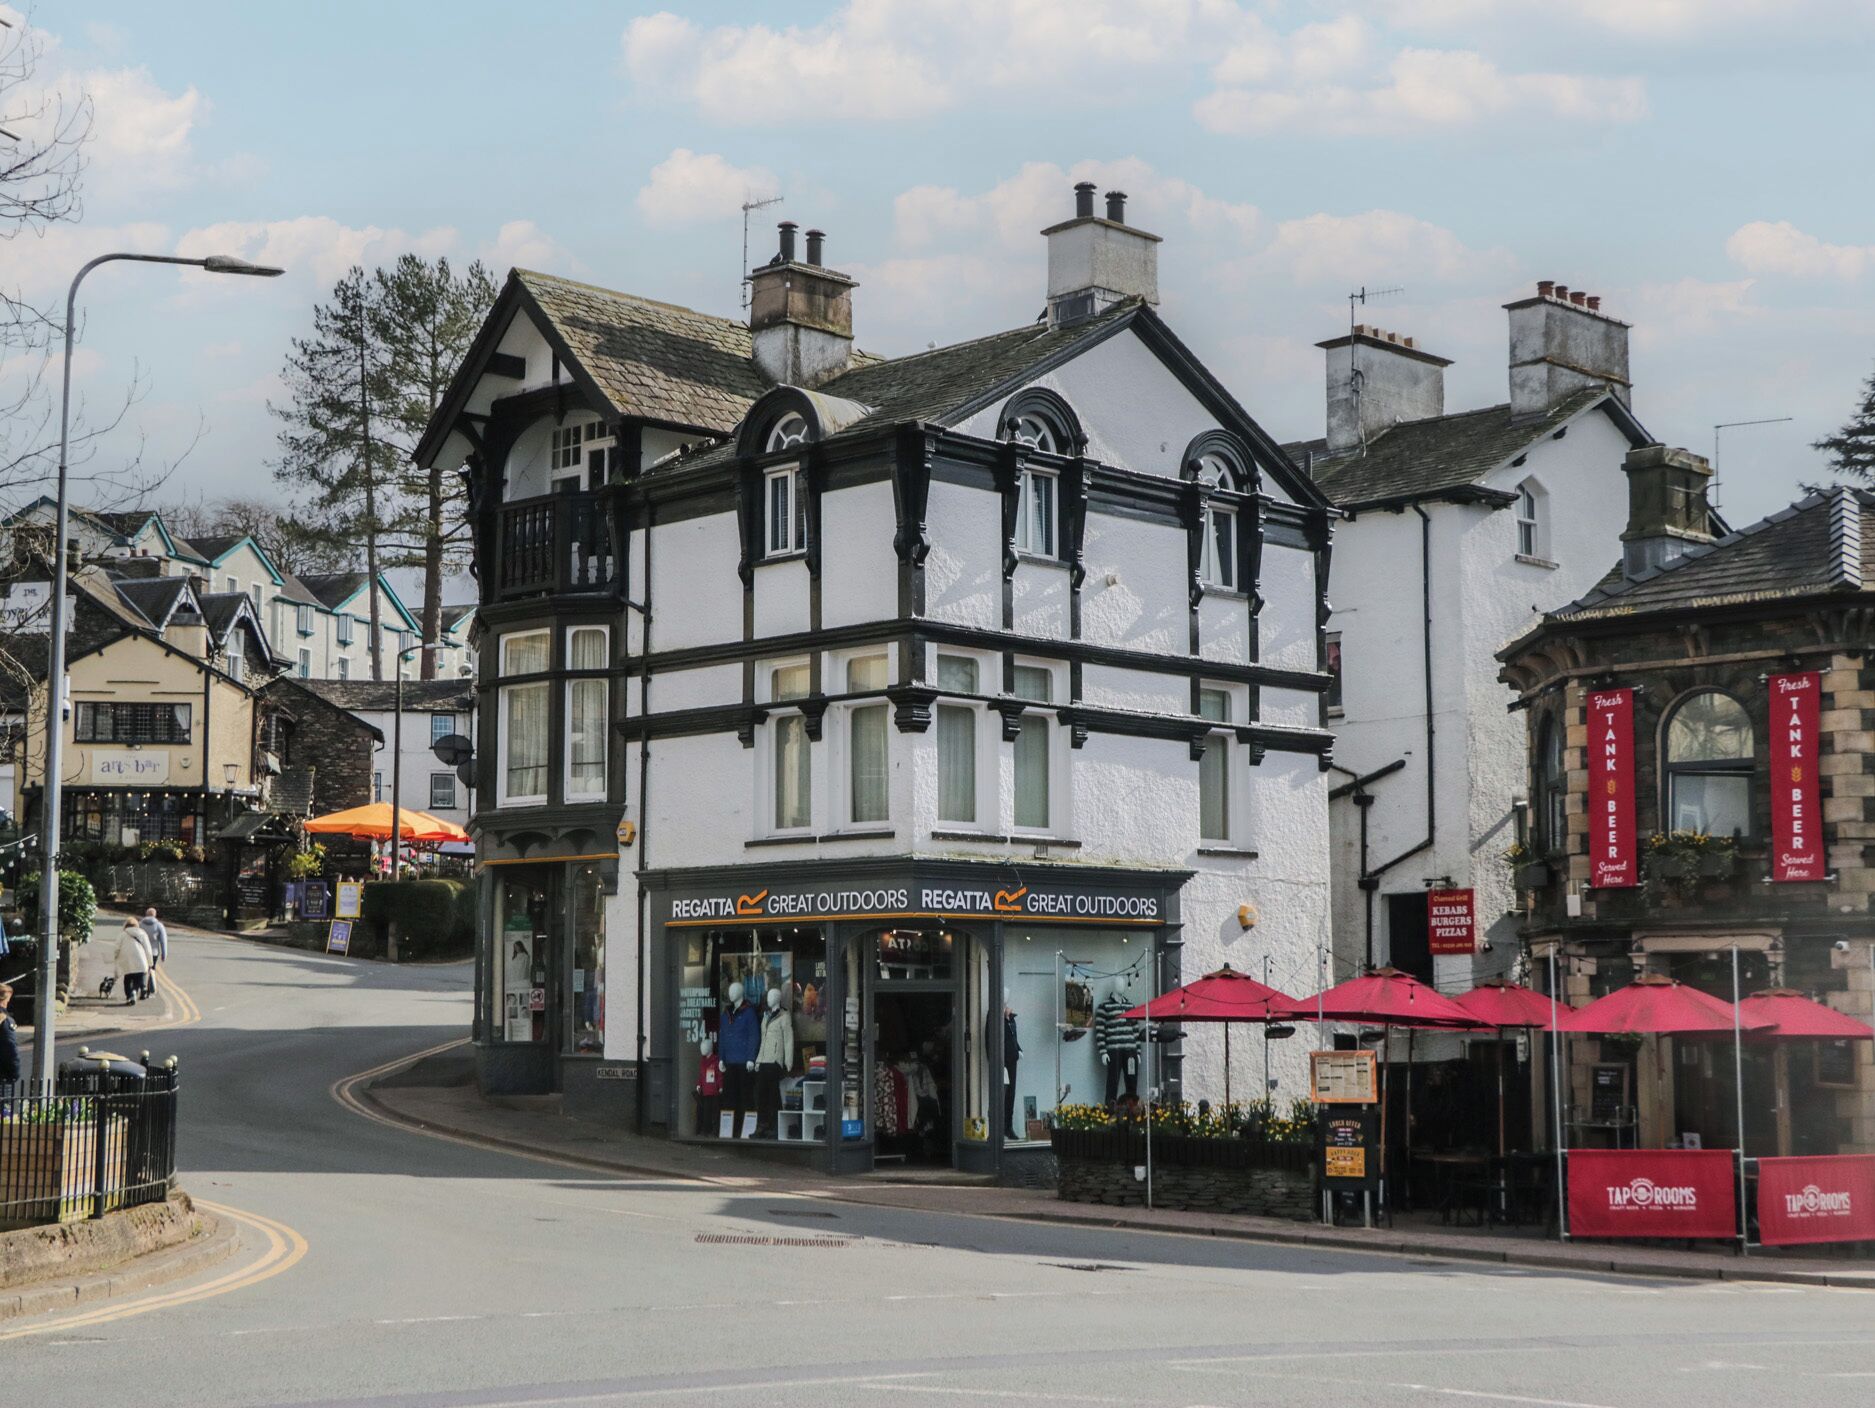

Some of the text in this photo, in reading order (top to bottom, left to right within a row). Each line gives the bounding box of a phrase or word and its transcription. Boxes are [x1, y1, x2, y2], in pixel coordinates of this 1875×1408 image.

[1777, 676, 1811, 694] Fresh
[1594, 693, 1623, 710] Fresh
[135, 760, 160, 774] bar
[1789, 696, 1804, 849] TANK BEER
[1605, 713, 1617, 858] TANK BEER
[1598, 861, 1628, 875] Served
[1781, 853, 1815, 867] Served
[1603, 873, 1625, 885] Here
[1785, 866, 1810, 881] Here
[672, 897, 735, 918] REGATTA
[768, 893, 815, 913] GREAT
[817, 889, 908, 912] OUTDOORS
[922, 889, 992, 911] REGATTA
[1027, 893, 1073, 913] GREAT
[1076, 895, 1157, 915] OUTDOORS
[1432, 905, 1468, 915] KEBABS
[1431, 916, 1472, 926] BURGERS
[1436, 927, 1467, 937] PIZZAS
[1606, 1187, 1697, 1205] TAP ROOMS
[1785, 1192, 1850, 1212] TAP ROOMS
